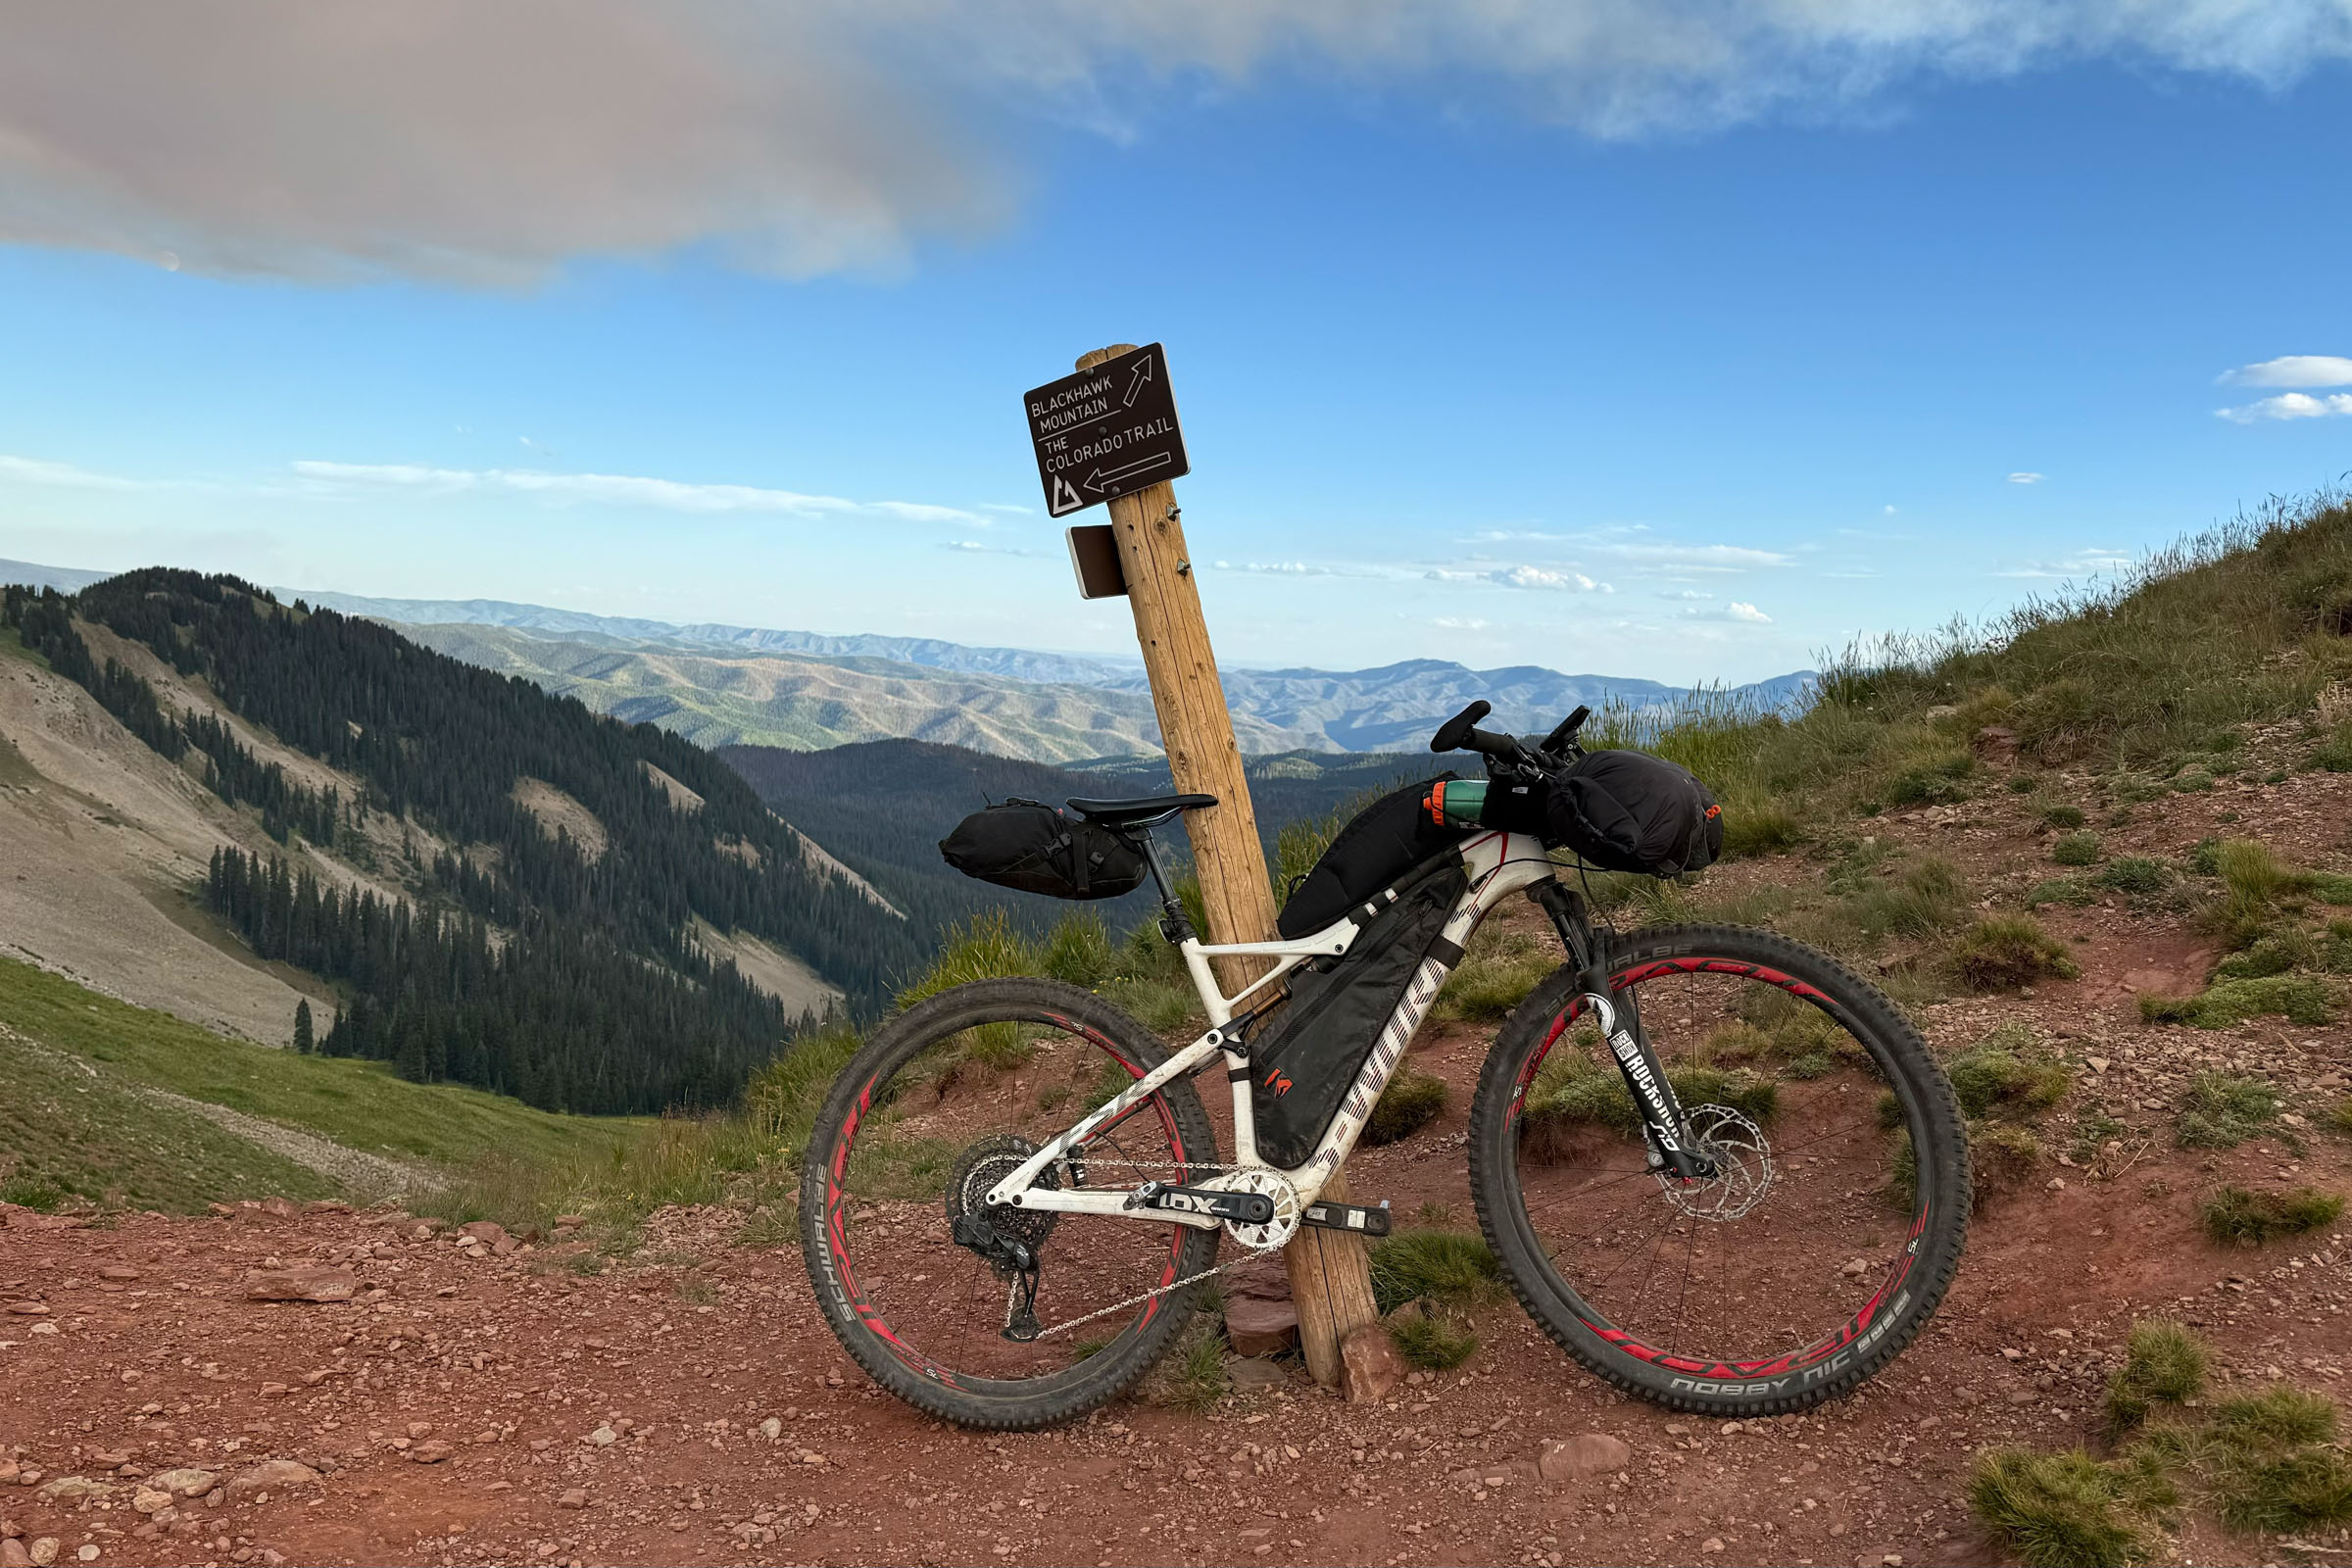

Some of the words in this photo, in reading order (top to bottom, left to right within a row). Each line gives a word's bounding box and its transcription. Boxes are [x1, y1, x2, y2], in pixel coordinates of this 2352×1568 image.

[1031, 374, 1113, 417] BLACKHAWK
[1040, 397, 1108, 434] MOUNTAIN
[1045, 436, 1069, 454] THE
[1046, 434, 1123, 473] COLORADO
[1124, 416, 1174, 444] TRAIL
[1611, 1032, 1632, 1050] ROCK
[1618, 1043, 1637, 1059] SHOX
[813, 1163, 857, 1322] SCHWALBE
[1670, 1376, 1790, 1397] NOBBY
[1803, 1350, 1851, 1385] NIC
